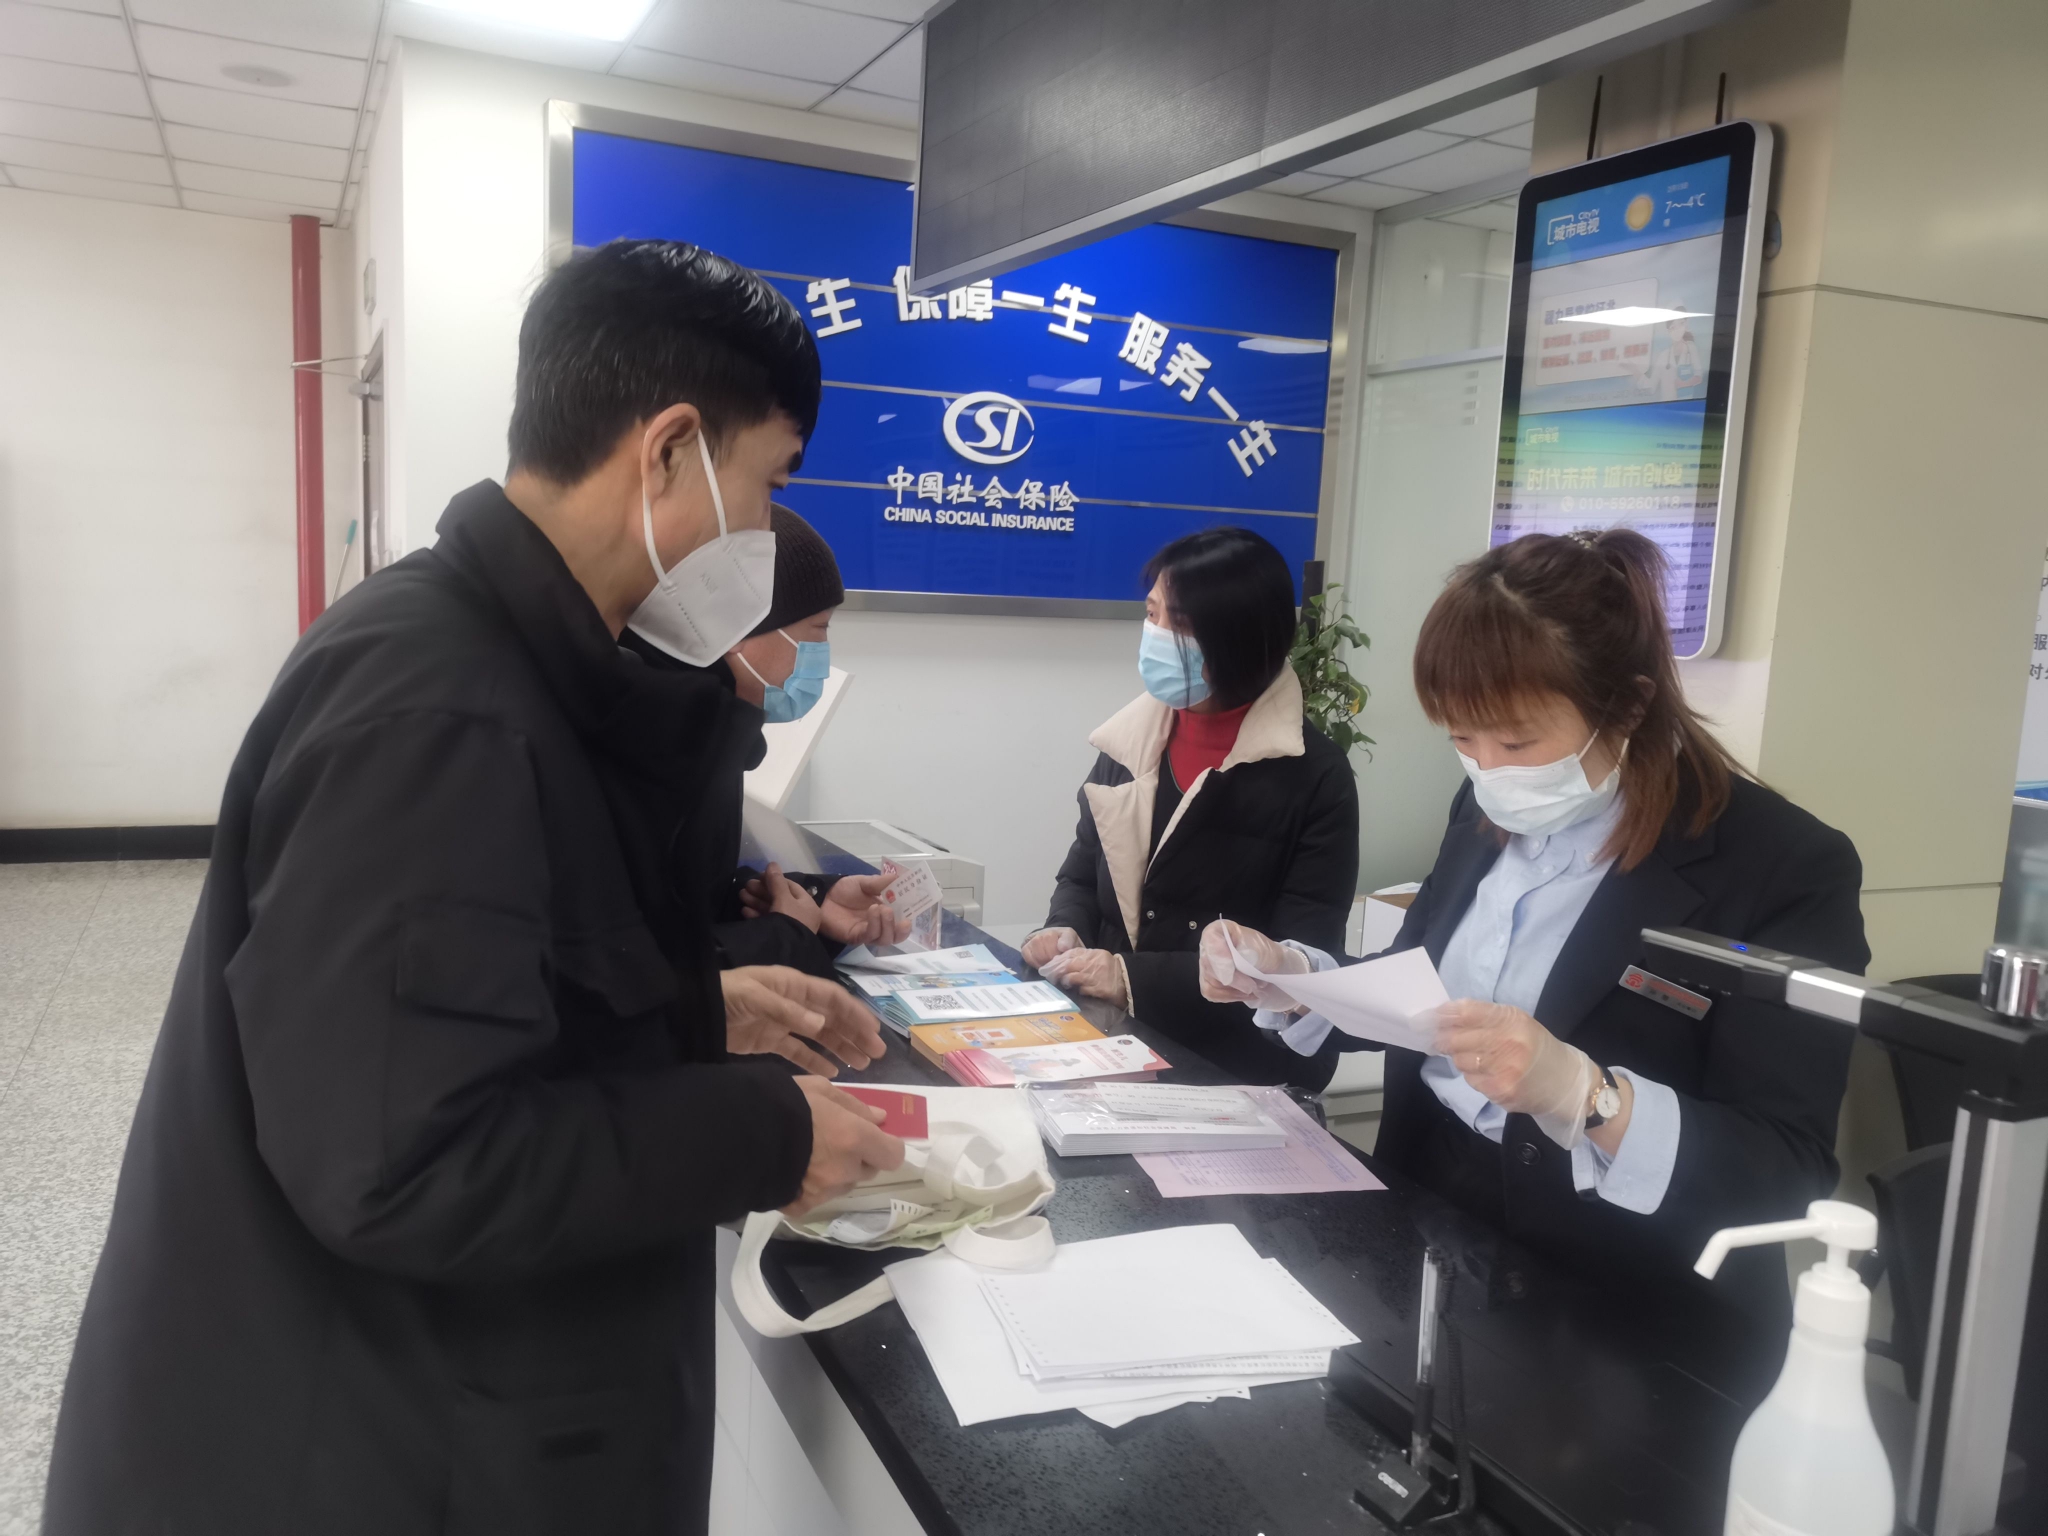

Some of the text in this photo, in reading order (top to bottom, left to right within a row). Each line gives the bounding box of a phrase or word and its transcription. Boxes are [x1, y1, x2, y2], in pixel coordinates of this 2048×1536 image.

[1553, 217, 1600, 241] 城市电视
[804, 278, 862, 338] 生
[1118, 311, 1278, 478] 服务一生
[887, 465, 1080, 512] 中国社会保险
[1527, 466, 1598, 491] 时代未来
[884, 506, 1075, 531] CHINA SOCIAL INSURANCE
[2030, 663, 2048, 680] 对
